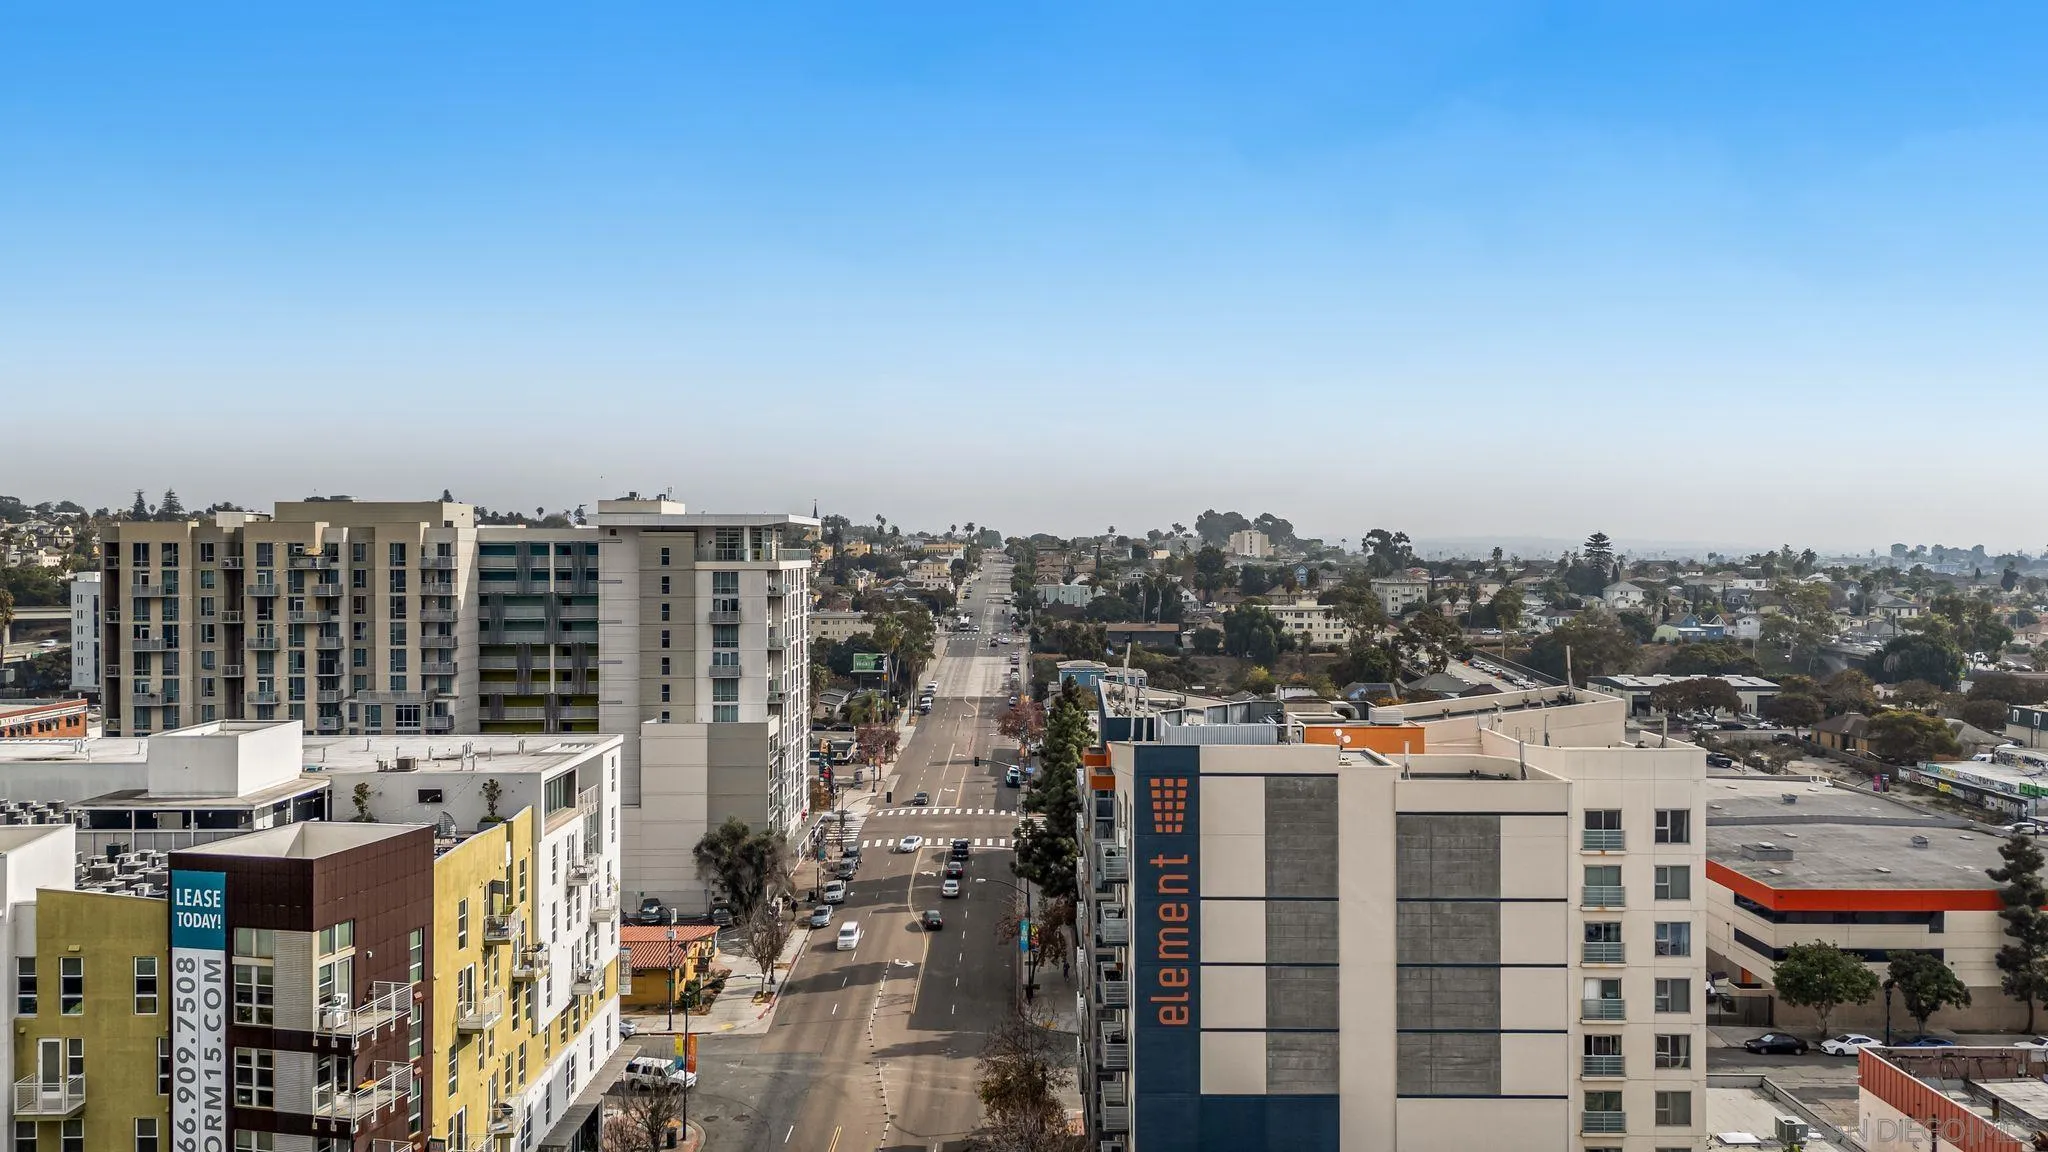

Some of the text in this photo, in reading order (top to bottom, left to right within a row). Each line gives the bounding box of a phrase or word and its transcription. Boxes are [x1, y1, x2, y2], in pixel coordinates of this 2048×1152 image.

[176, 888, 221, 908] LEASE
[176, 911, 221, 929] TODAY!
[1150, 854, 1189, 1025] element
[176, 957, 196, 1152] 66.909.7508
[203, 959, 222, 1152] ORM15.COM
